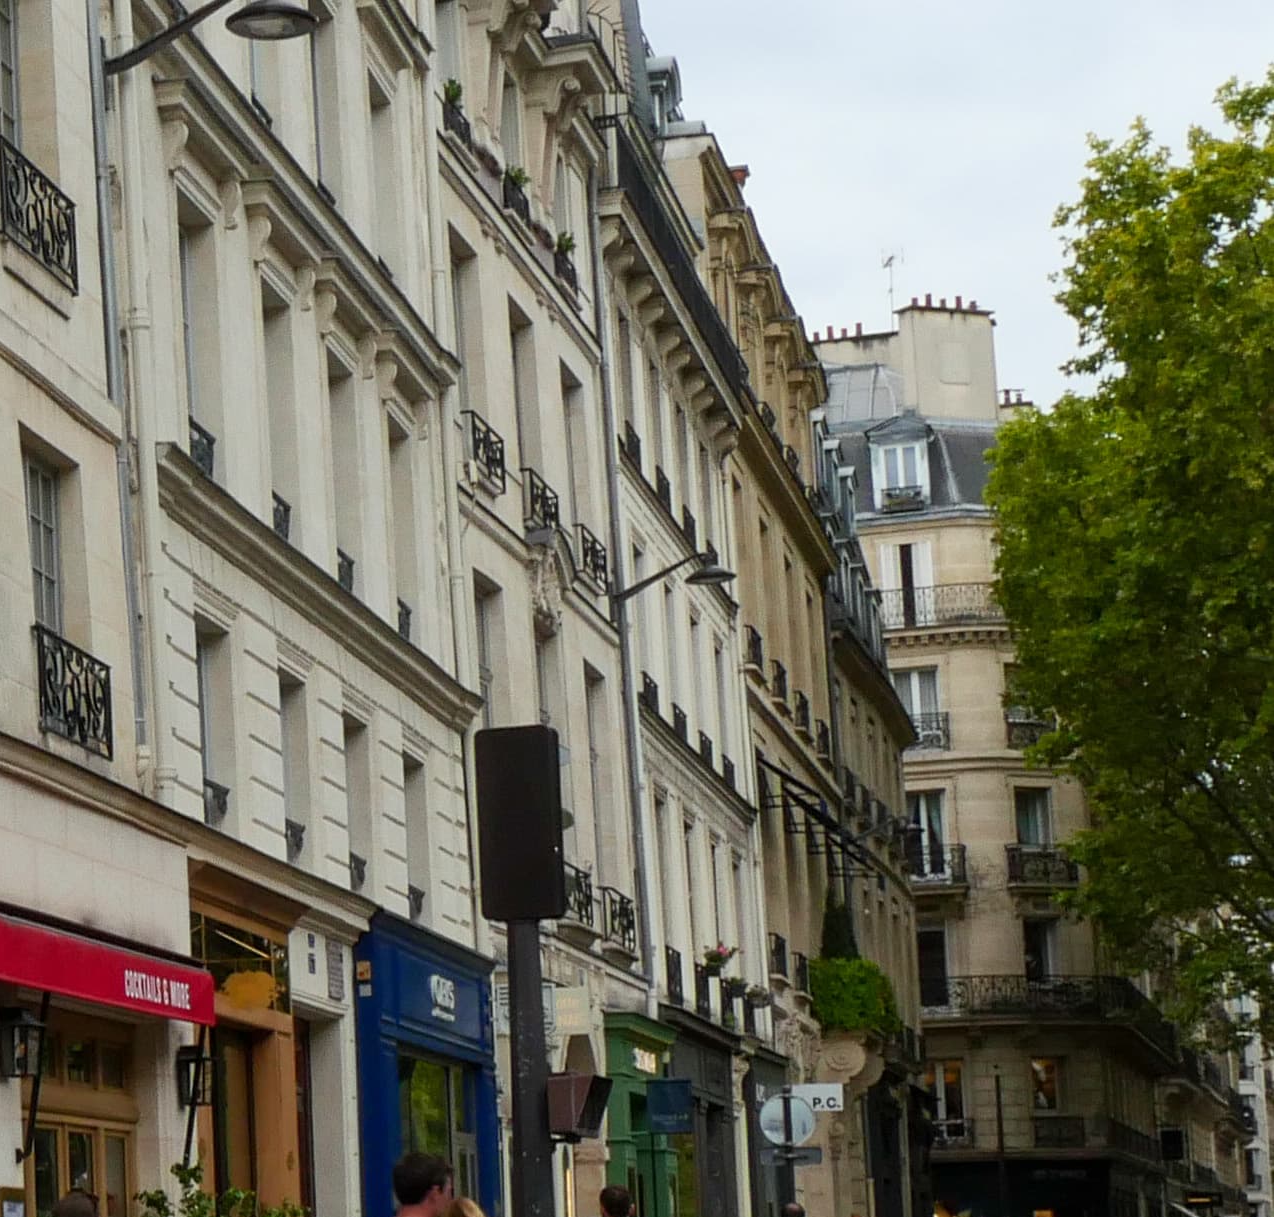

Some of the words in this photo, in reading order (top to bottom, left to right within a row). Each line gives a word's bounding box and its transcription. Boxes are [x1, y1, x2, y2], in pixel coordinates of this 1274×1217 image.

[124, 968, 162, 1004] COCKTAILS
[169, 980, 192, 1011] MORE
[812, 1097, 841, 1109] P.C.
